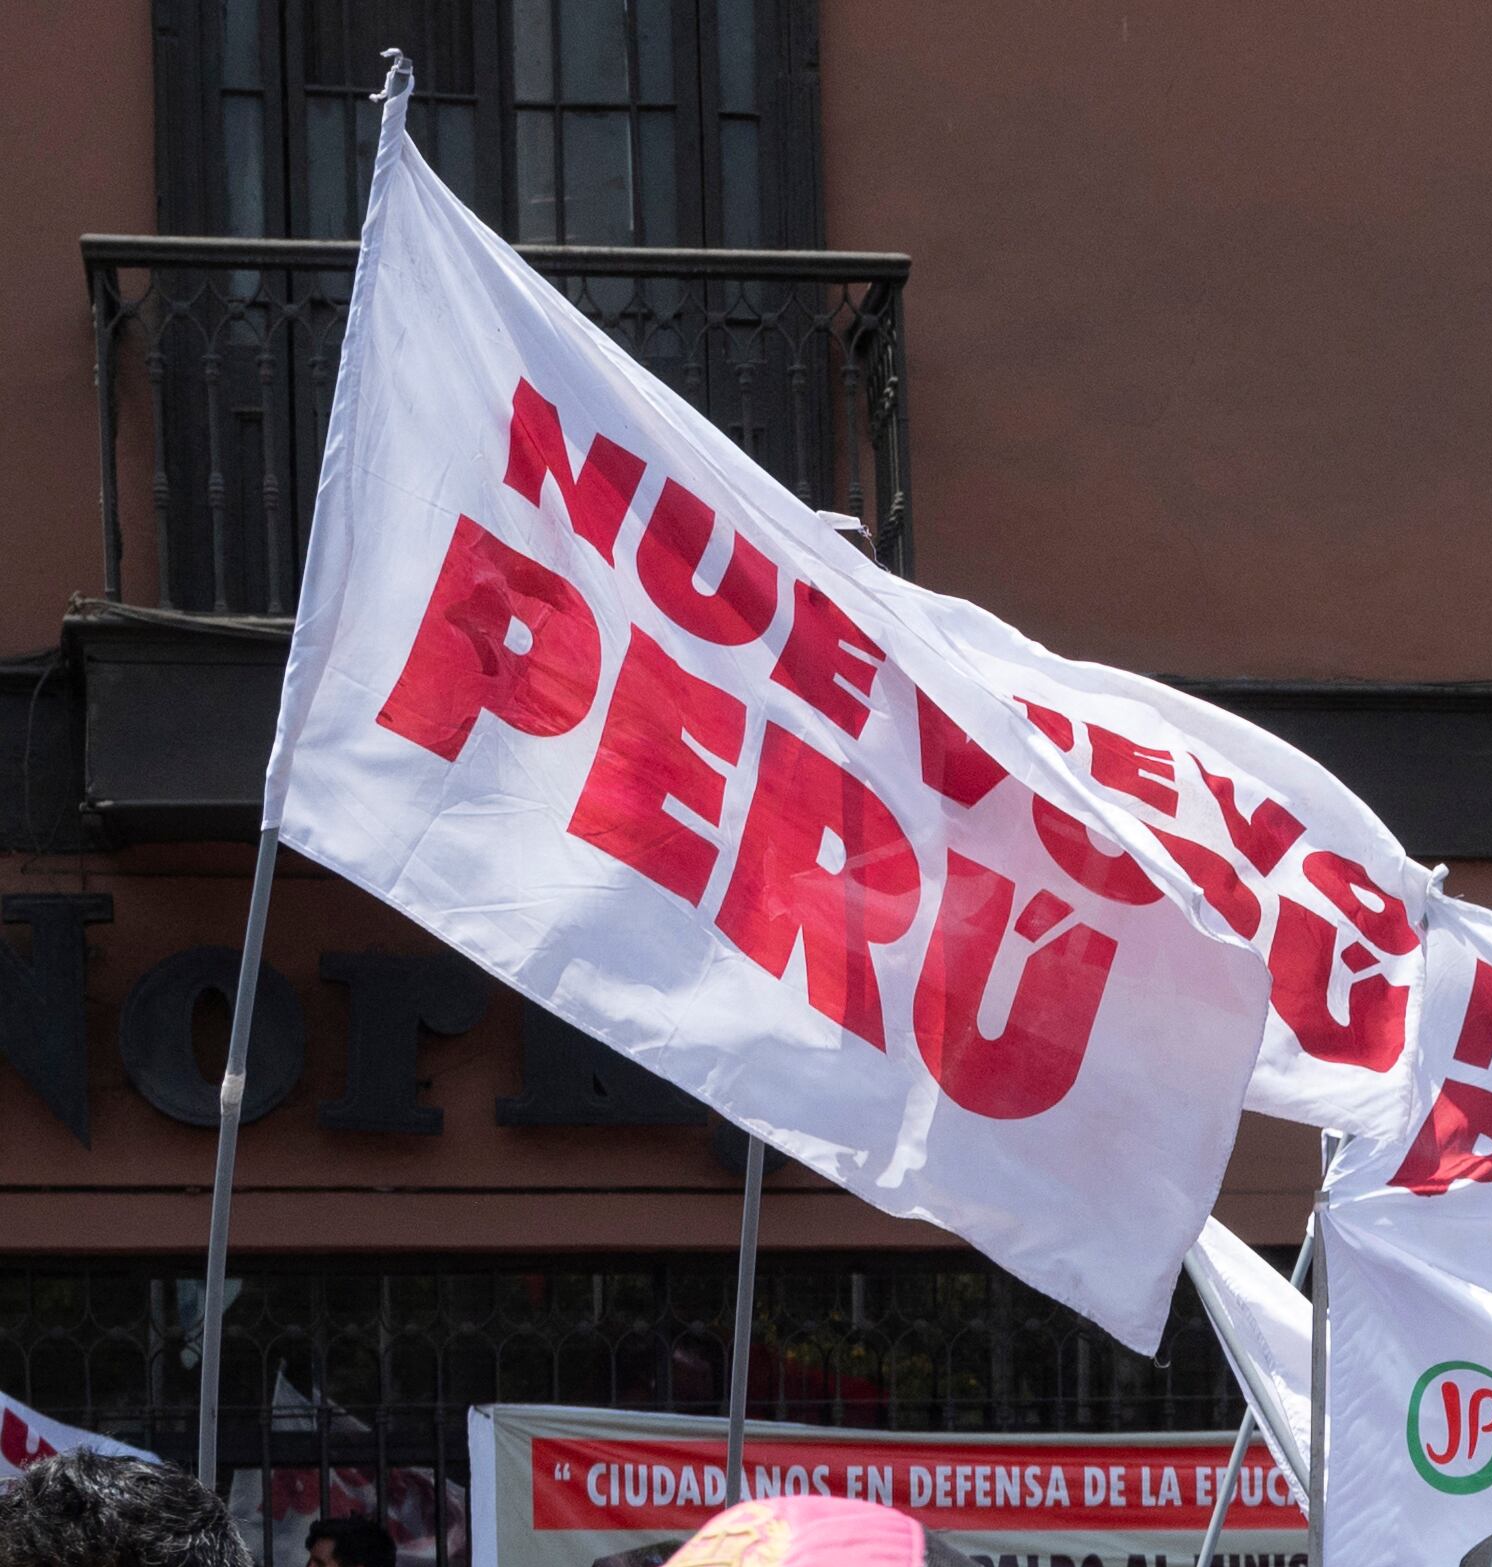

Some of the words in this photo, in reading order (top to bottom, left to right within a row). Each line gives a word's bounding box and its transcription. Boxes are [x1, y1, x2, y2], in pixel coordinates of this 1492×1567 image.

[375, 512, 1120, 1120] PERÚ
[846, 1465, 894, 1507] EN
[909, 1465, 1070, 1508] DEFENSA
[1083, 1466, 1127, 1508] DE
[1141, 1466, 1182, 1507] LA
[1195, 1466, 1300, 1507] EUC
